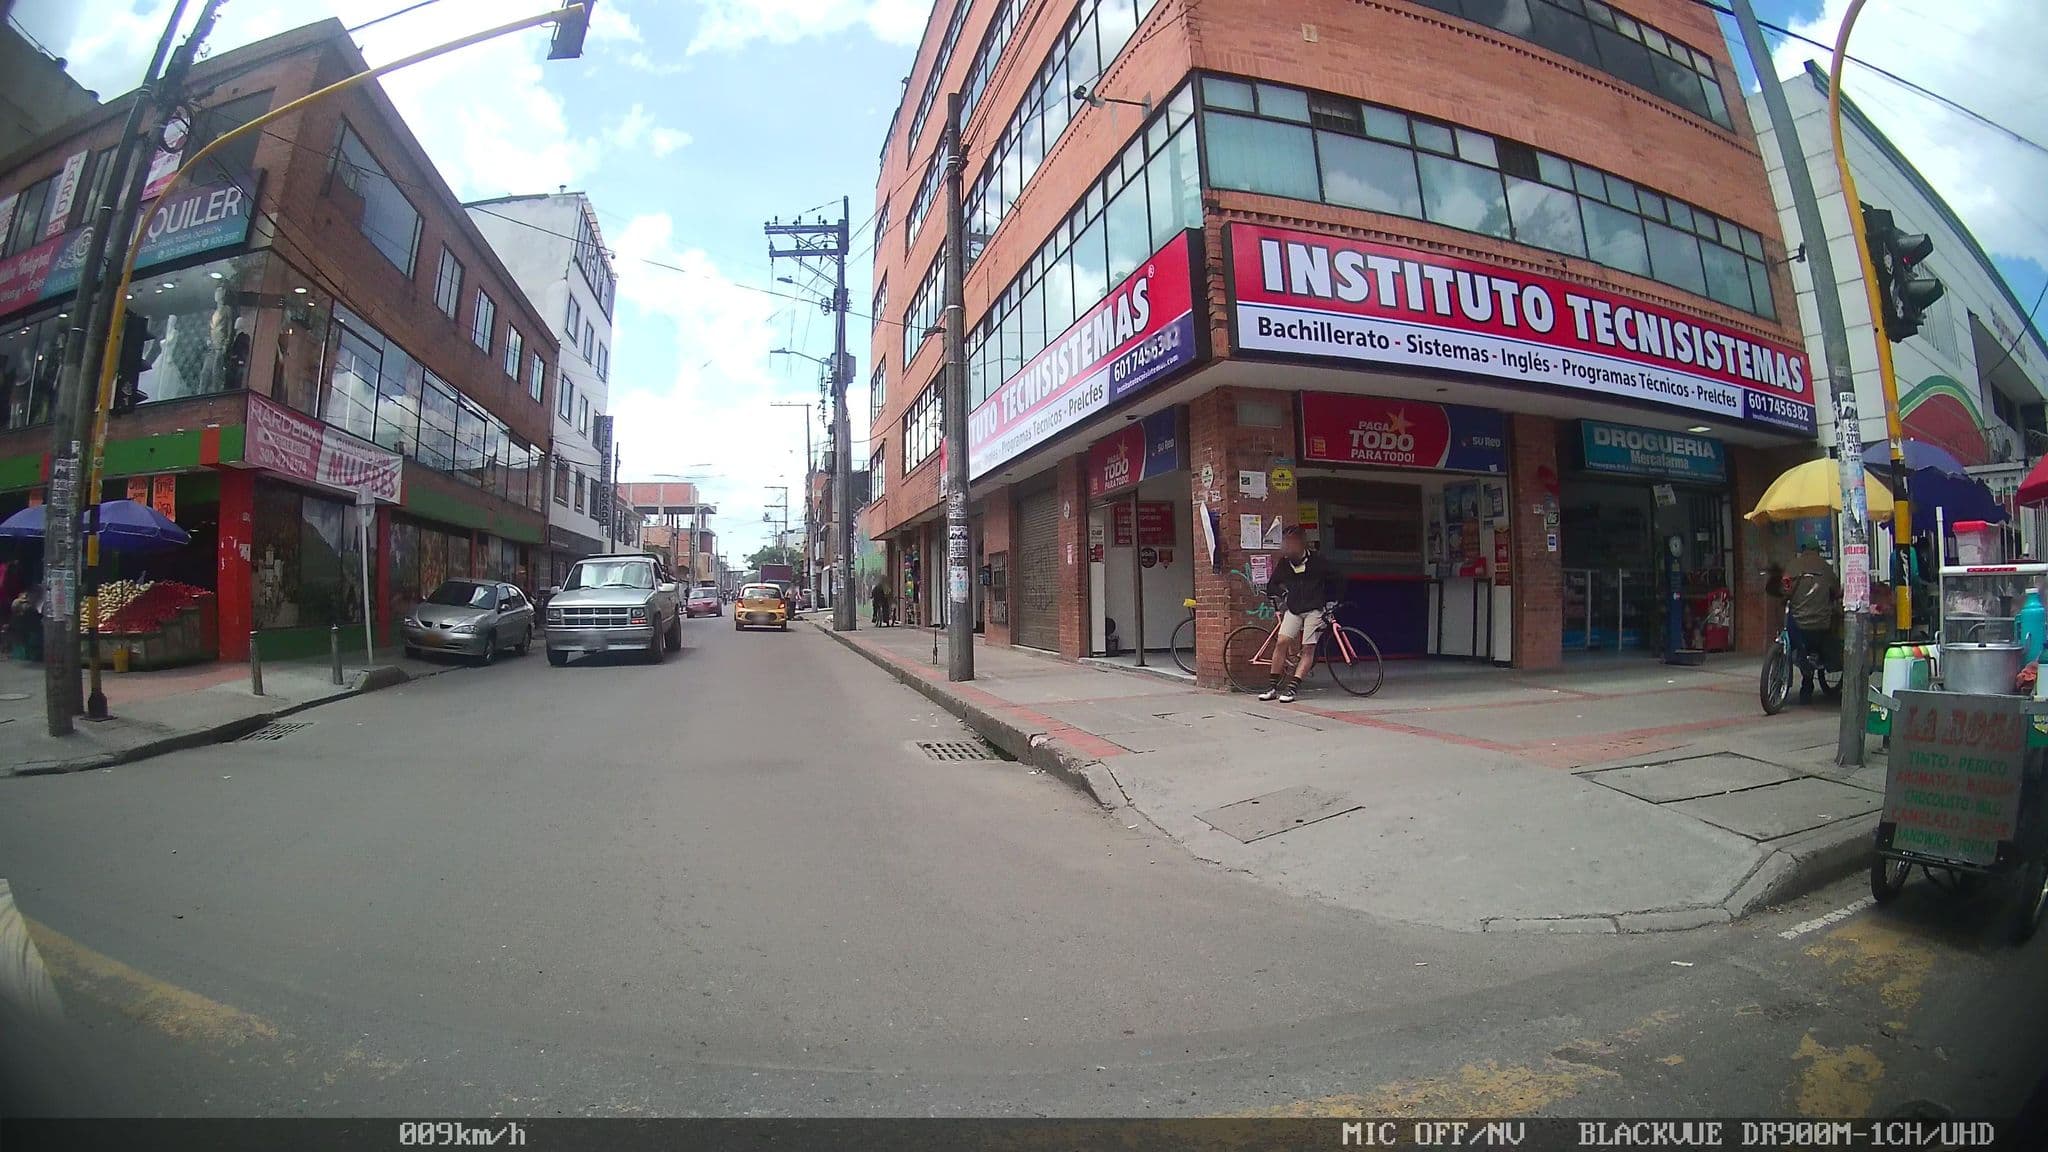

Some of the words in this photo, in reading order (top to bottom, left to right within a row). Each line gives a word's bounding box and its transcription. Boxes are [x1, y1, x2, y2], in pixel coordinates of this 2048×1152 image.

[1259, 238, 1555, 333] INSTITUTO
[1566, 293, 1806, 394] TECNISISTEMAS
[1001, 276, 1151, 425] TECNISISTEMAS
[1257, 316, 1390, 350] Bachillerato
[1406, 334, 1489, 363] Sistemas
[1501, 348, 1550, 374] Inglés
[1562, 358, 1637, 387] Programas
[1639, 373, 1690, 398] Técnicos
[1748, 392, 1809, 421] 6017456382
[1358, 420, 1389, 431] PAGA
[1349, 430, 1415, 452] TODO
[1593, 426, 1716, 460] DROGUERIA
[1104, 458, 1129, 481] TODO
[1908, 750, 1949, 769] TINTO
[1959, 755, 2008, 777] PERICO
